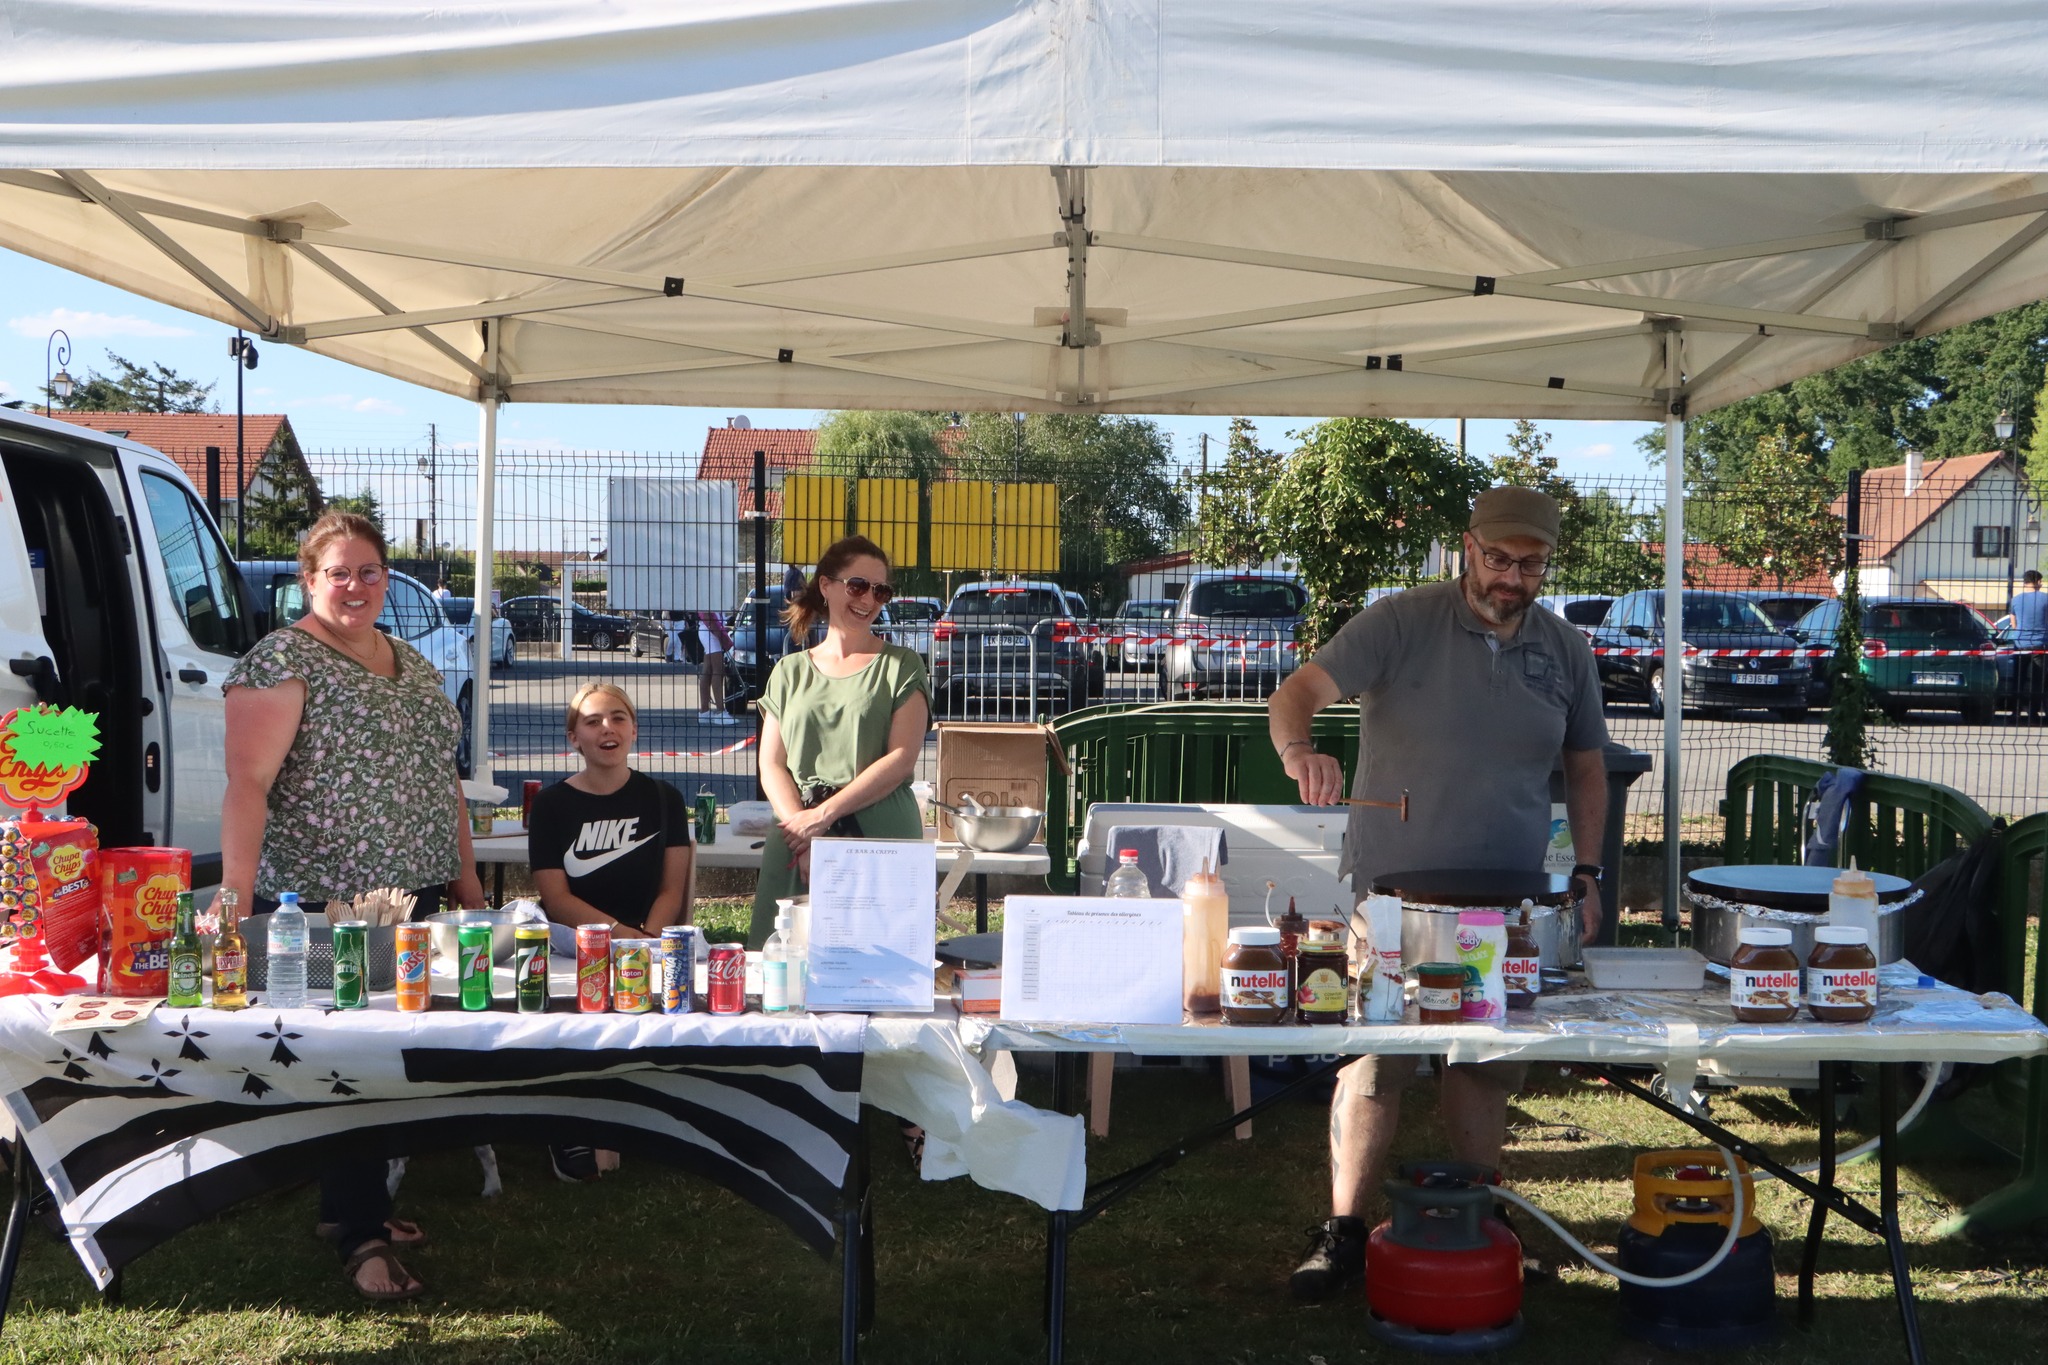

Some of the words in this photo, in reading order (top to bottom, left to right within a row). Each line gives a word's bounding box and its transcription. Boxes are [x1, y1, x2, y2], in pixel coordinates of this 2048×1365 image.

[23, 720, 76, 737] Sucette
[575, 816, 640, 852] NIKE
[53, 851, 80, 865] Chupa
[1555, 852, 1577, 862] Esso
[54, 860, 81, 876] Chups
[62, 879, 84, 895] BEST
[144, 887, 177, 905] Chup
[141, 901, 177, 924] Chup
[1456, 934, 1482, 948] Daddy
[150, 953, 169, 969] BE
[397, 950, 427, 981] Oasis
[708, 953, 747, 979] ca-Col
[1501, 959, 1537, 974] tella
[621, 970, 642, 978] Lipton
[1231, 973, 1286, 988] nutella
[1745, 972, 1799, 988] nutella
[1823, 971, 1876, 986] nutella
